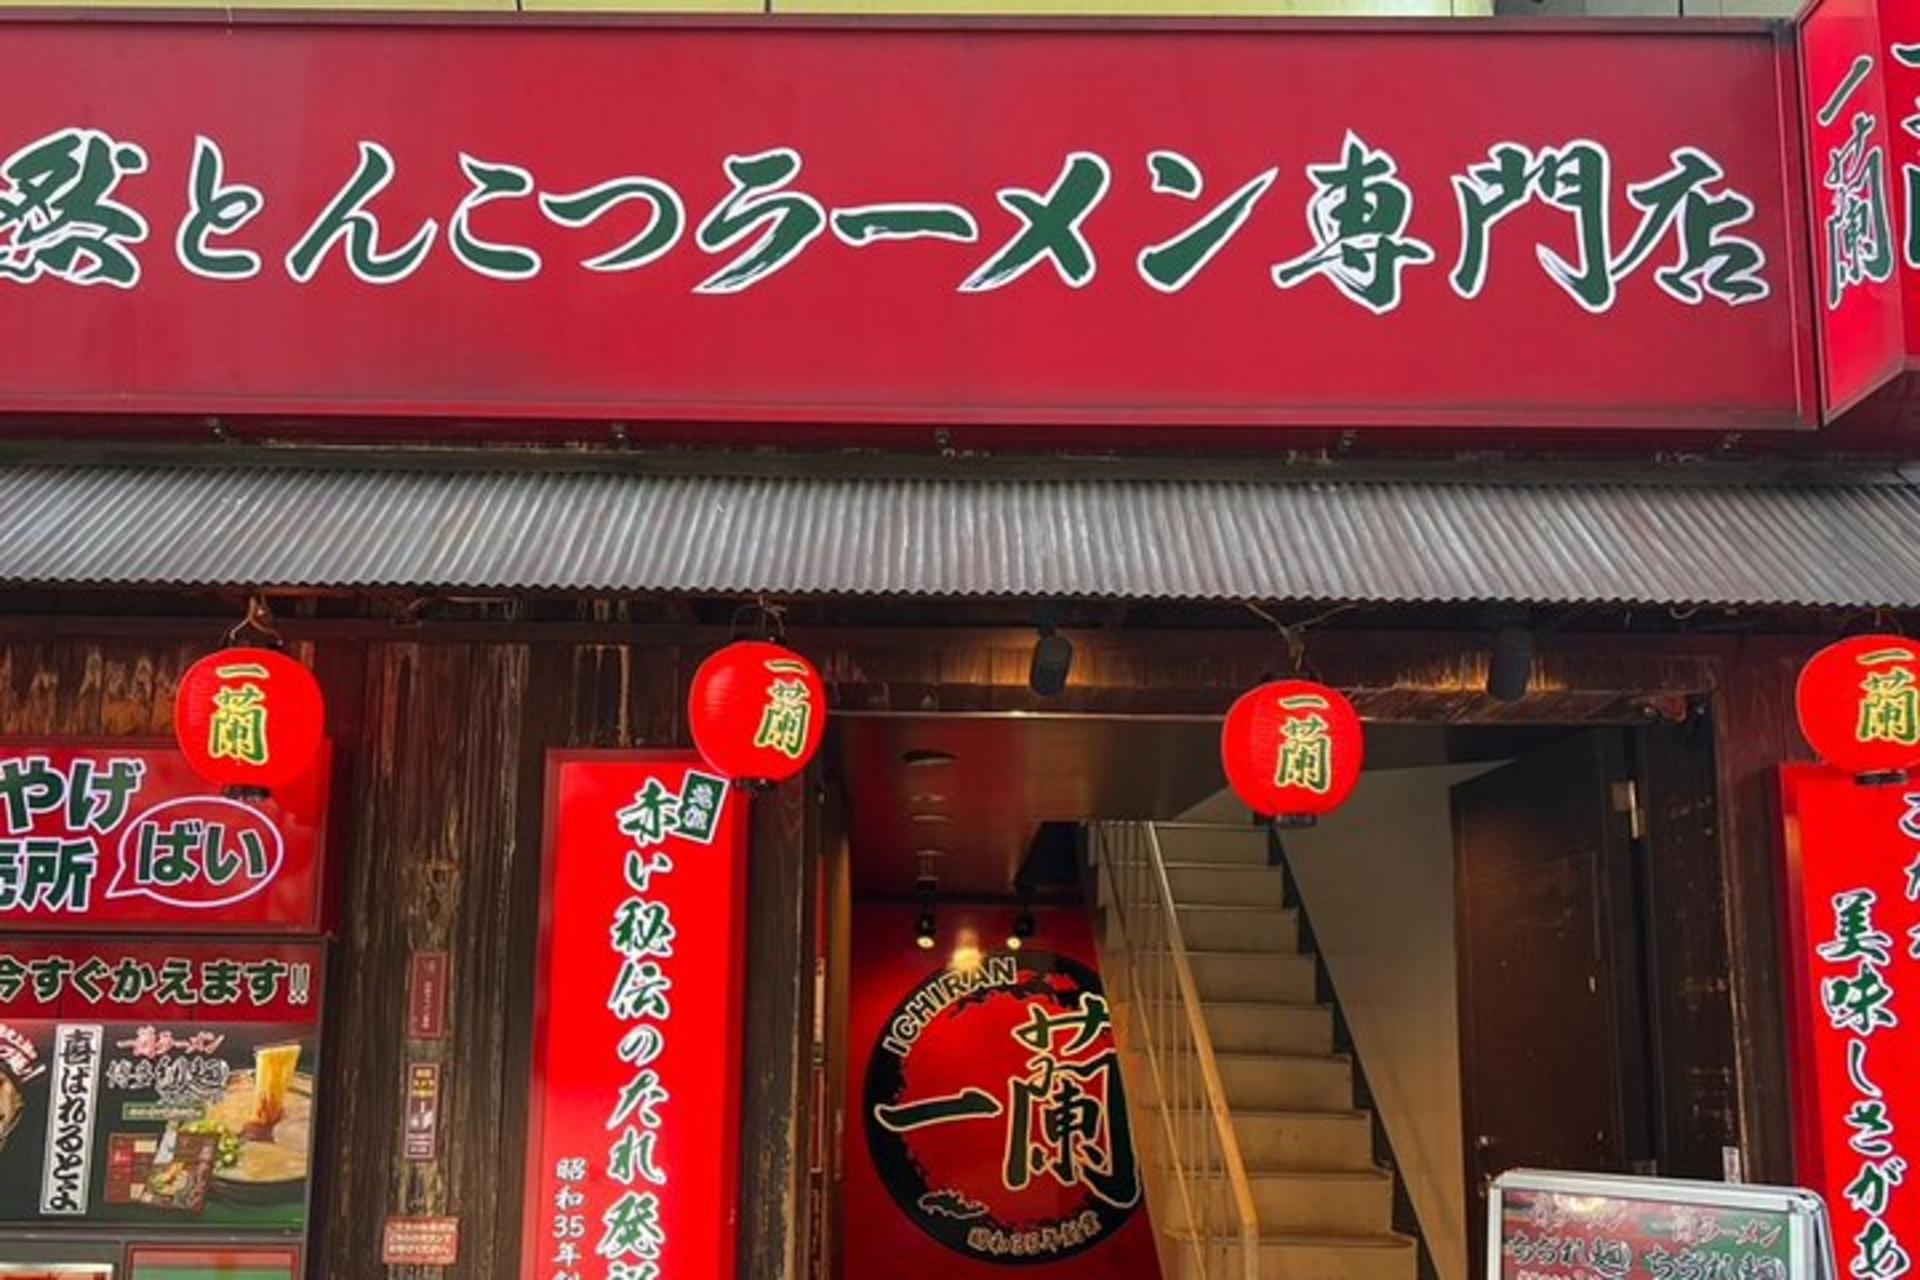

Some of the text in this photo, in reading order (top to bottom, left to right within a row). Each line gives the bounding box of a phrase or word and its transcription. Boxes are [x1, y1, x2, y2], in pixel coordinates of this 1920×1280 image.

[0, 128, 1770, 315] 然とんこつラーメン専門店
[1818, 55, 1895, 311] 一蘭
[208, 663, 270, 767] 一蘭
[753, 659, 811, 759] 一蘭
[1274, 693, 1331, 795] 一蘭
[1855, 648, 1920, 745] 一蘭
[0, 756, 144, 834] やげ
[0, 836, 99, 912] 所
[135, 820, 267, 886] ばい
[882, 956, 1018, 1057] ICHIRAN
[873, 992, 1142, 1208] 一蘭
